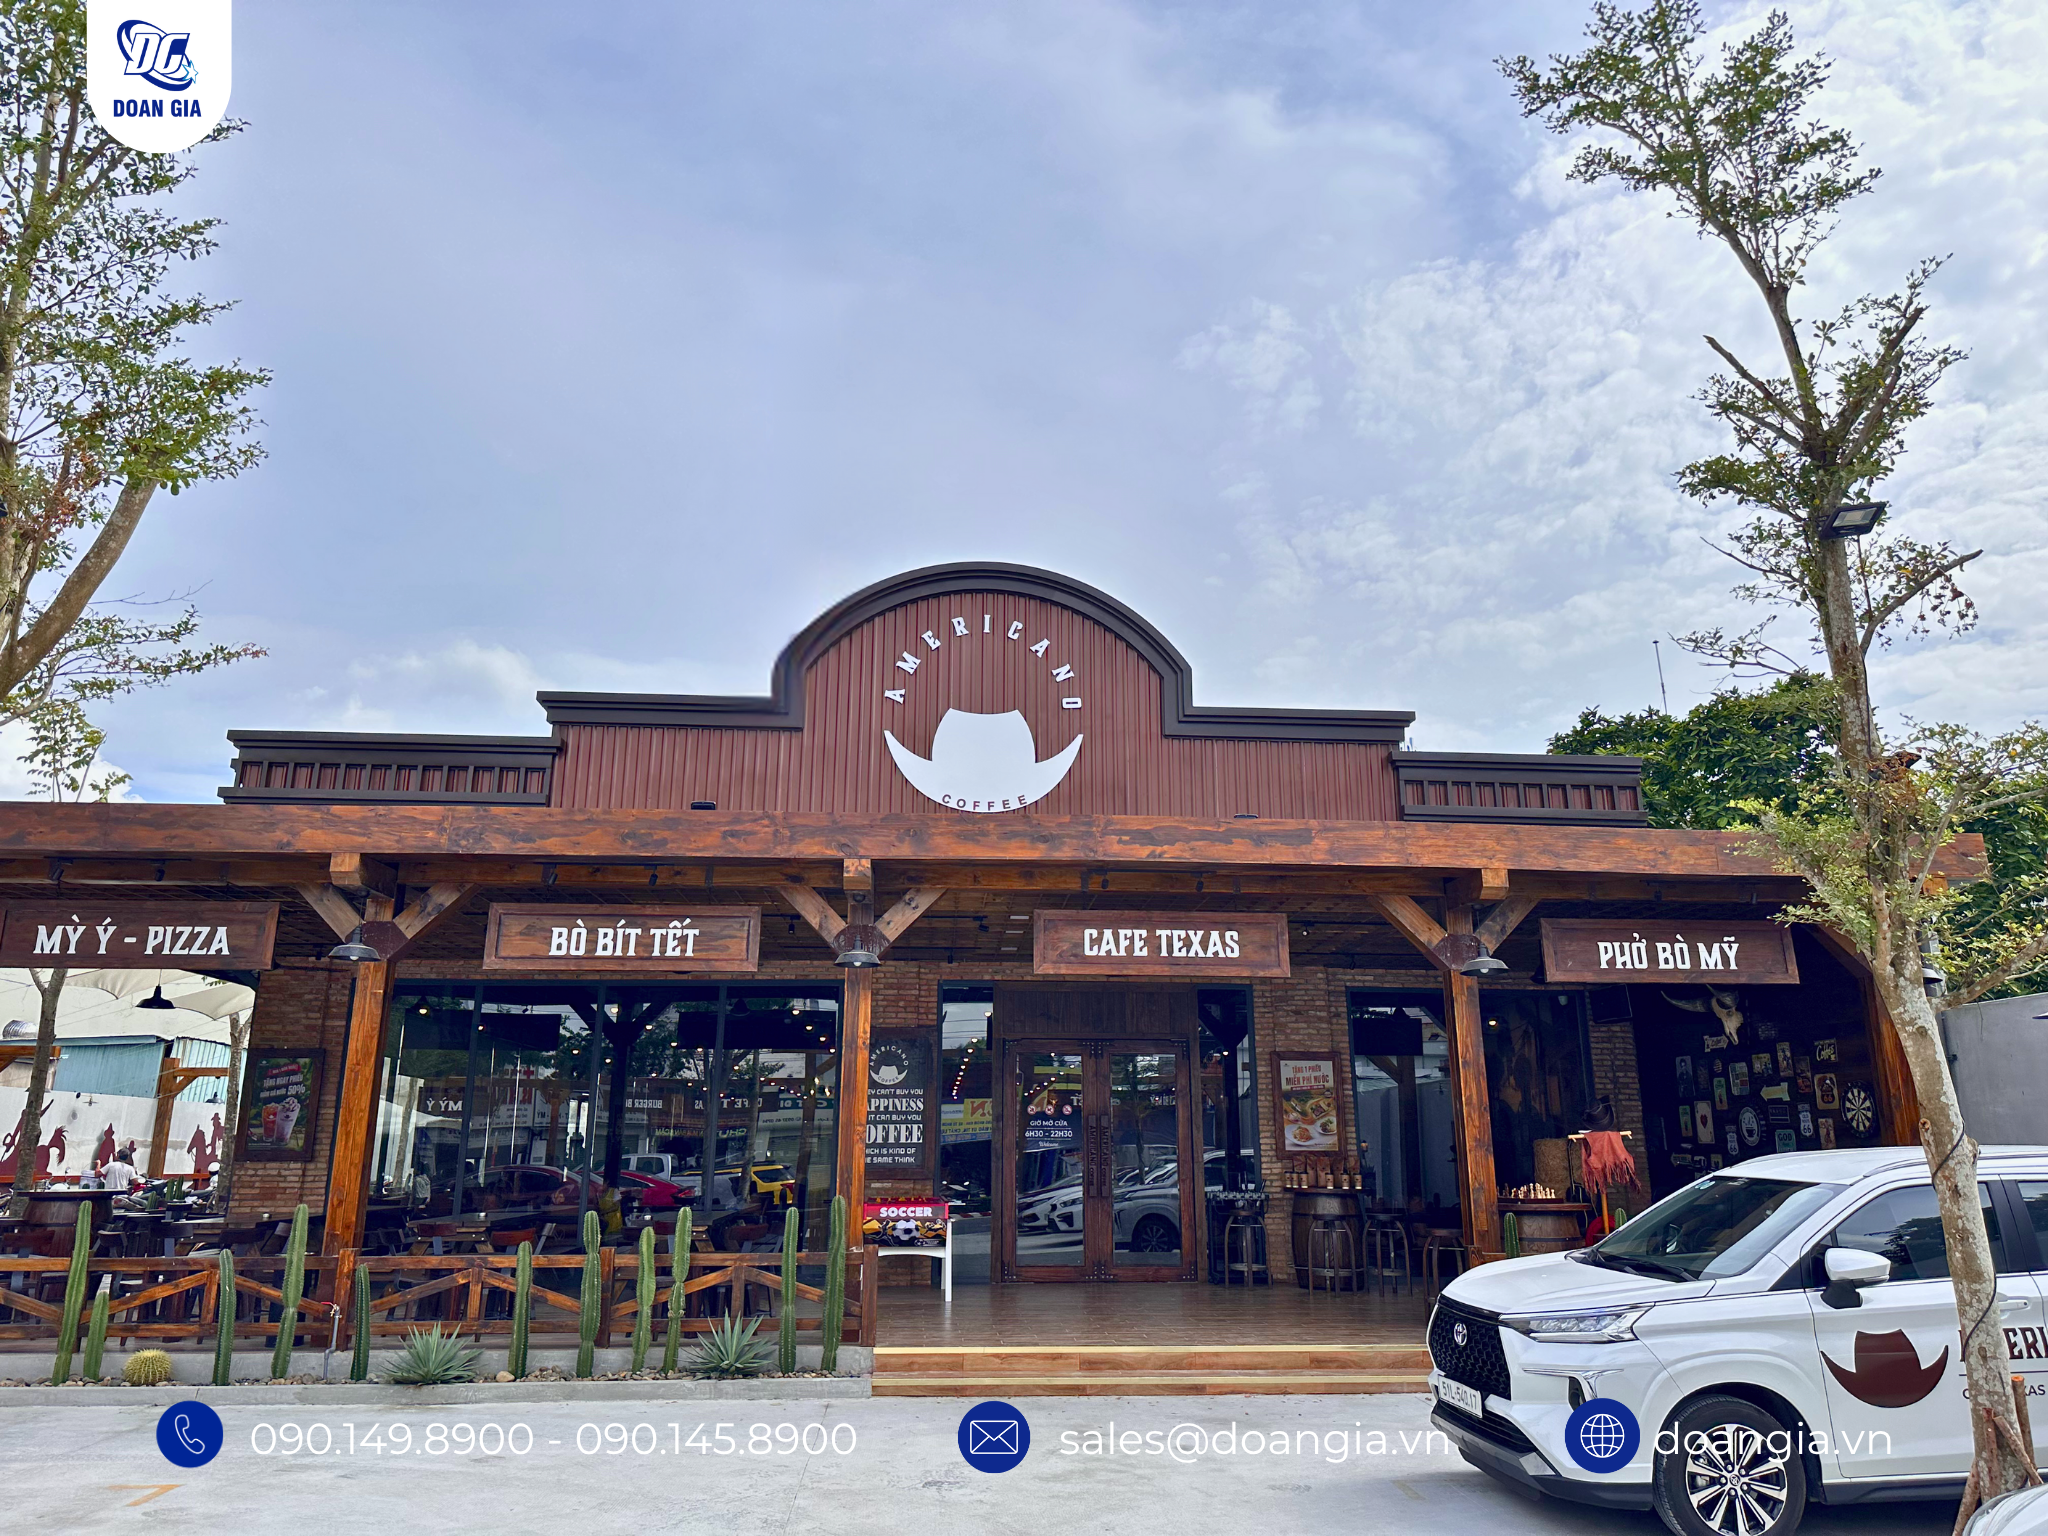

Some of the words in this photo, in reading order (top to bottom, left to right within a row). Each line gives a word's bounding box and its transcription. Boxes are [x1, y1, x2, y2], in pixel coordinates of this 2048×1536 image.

[884, 614, 1082, 710] AMERICANO
[942, 794, 1026, 810] COFFEE
[33, 914, 86, 954] MỲ
[96, 917, 117, 954] Ý
[144, 926, 230, 955] PIZZA
[549, 919, 588, 956] BÒ
[595, 919, 642, 956] BÍT
[650, 918, 700, 956] TẾT
[1084, 929, 1148, 956] CAFE
[1156, 930, 1240, 958] TEXAS
[1597, 932, 1648, 969] PHỞ
[1655, 934, 1691, 969] BÒ
[1697, 936, 1740, 970] MỸ
[870, 1046, 908, 1066] AMERICANO
[866, 1124, 923, 1143] OFFEE
[1778, 1133, 1792, 1142] GOD
[1803, 1124, 1812, 1133] 66
[880, 1207, 933, 1217] SOCCER
